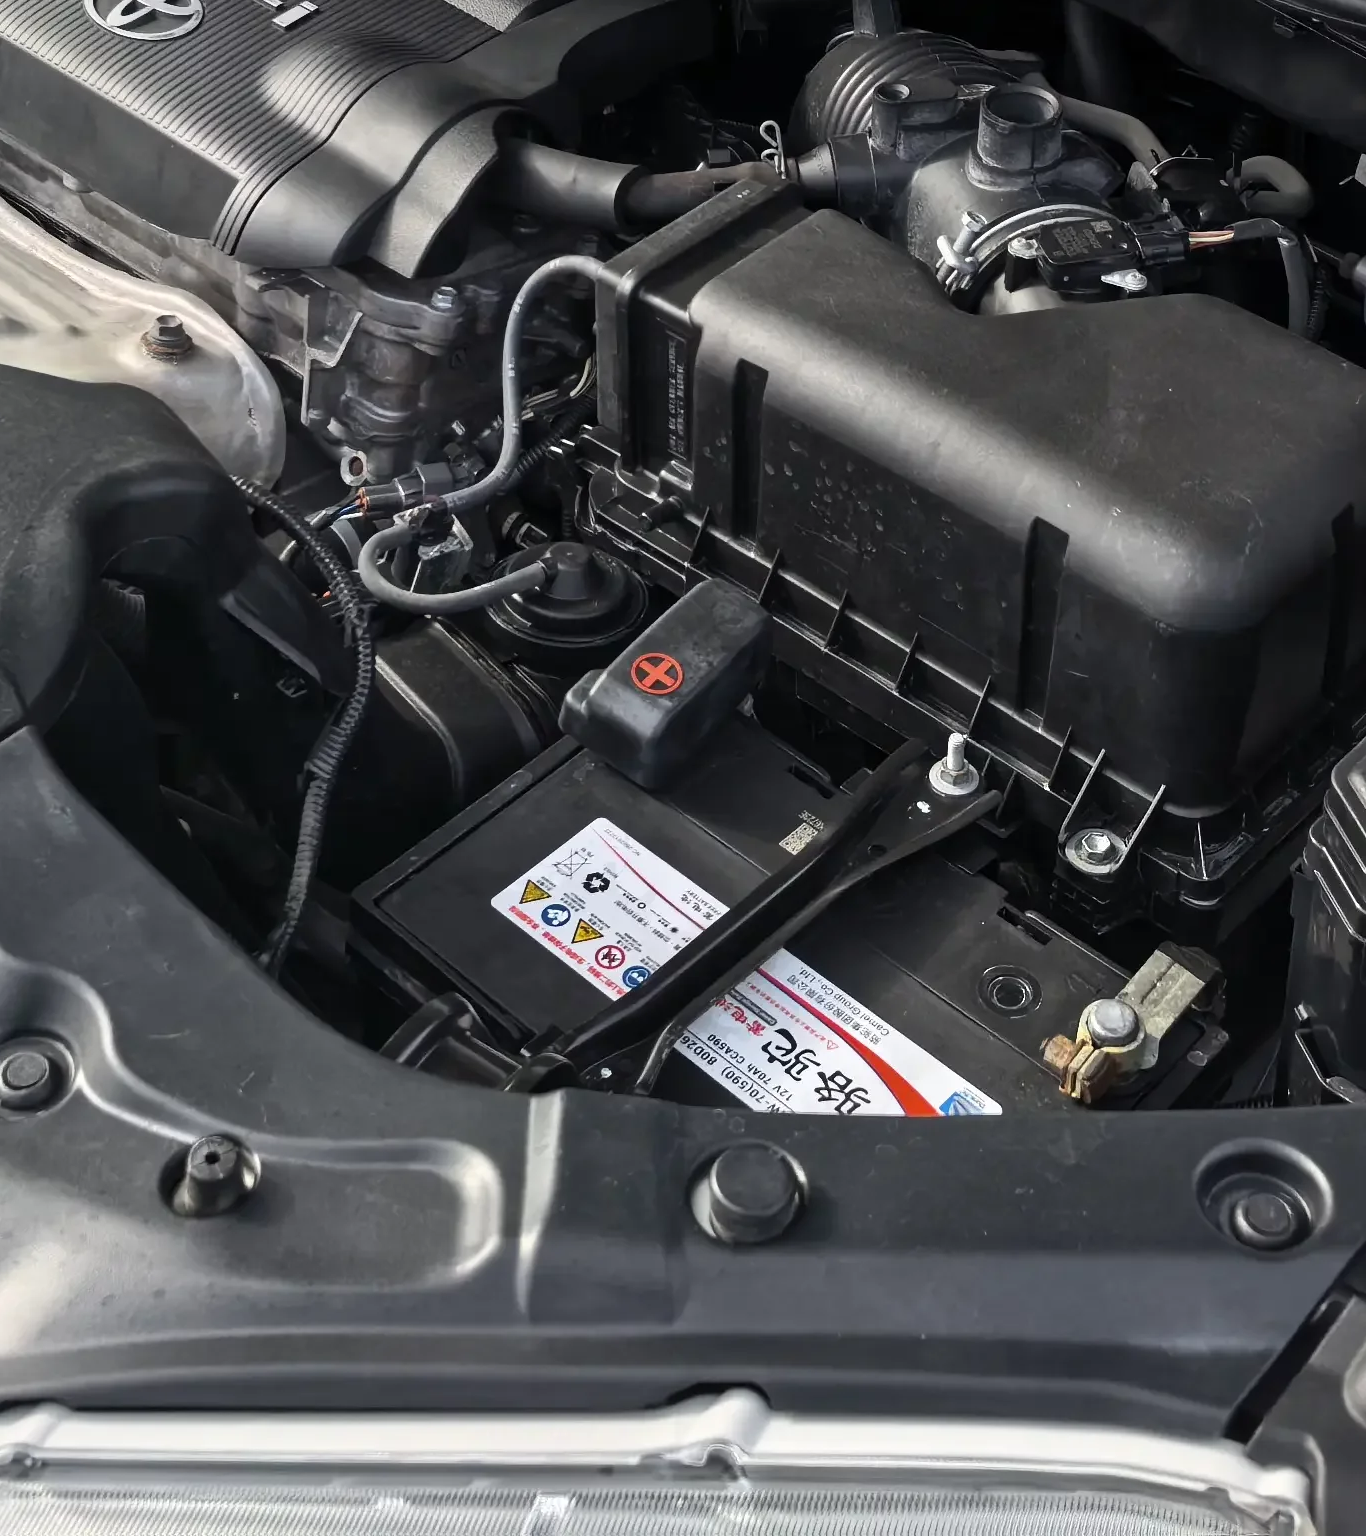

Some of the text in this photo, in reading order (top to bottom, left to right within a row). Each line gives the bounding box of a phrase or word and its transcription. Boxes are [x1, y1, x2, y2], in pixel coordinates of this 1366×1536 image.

[798, 966, 816, 984] Ltd.
[786, 973, 882, 1046] 骆驼集团股份有限公司
[833, 990, 862, 1018] Group
[860, 1010, 890, 1037] Camel
[707, 1033, 795, 1103] 12V 70Ah CCA590
[720, 1065, 791, 1114] W-70(590)
[761, 1027, 871, 1115] 骆驼
